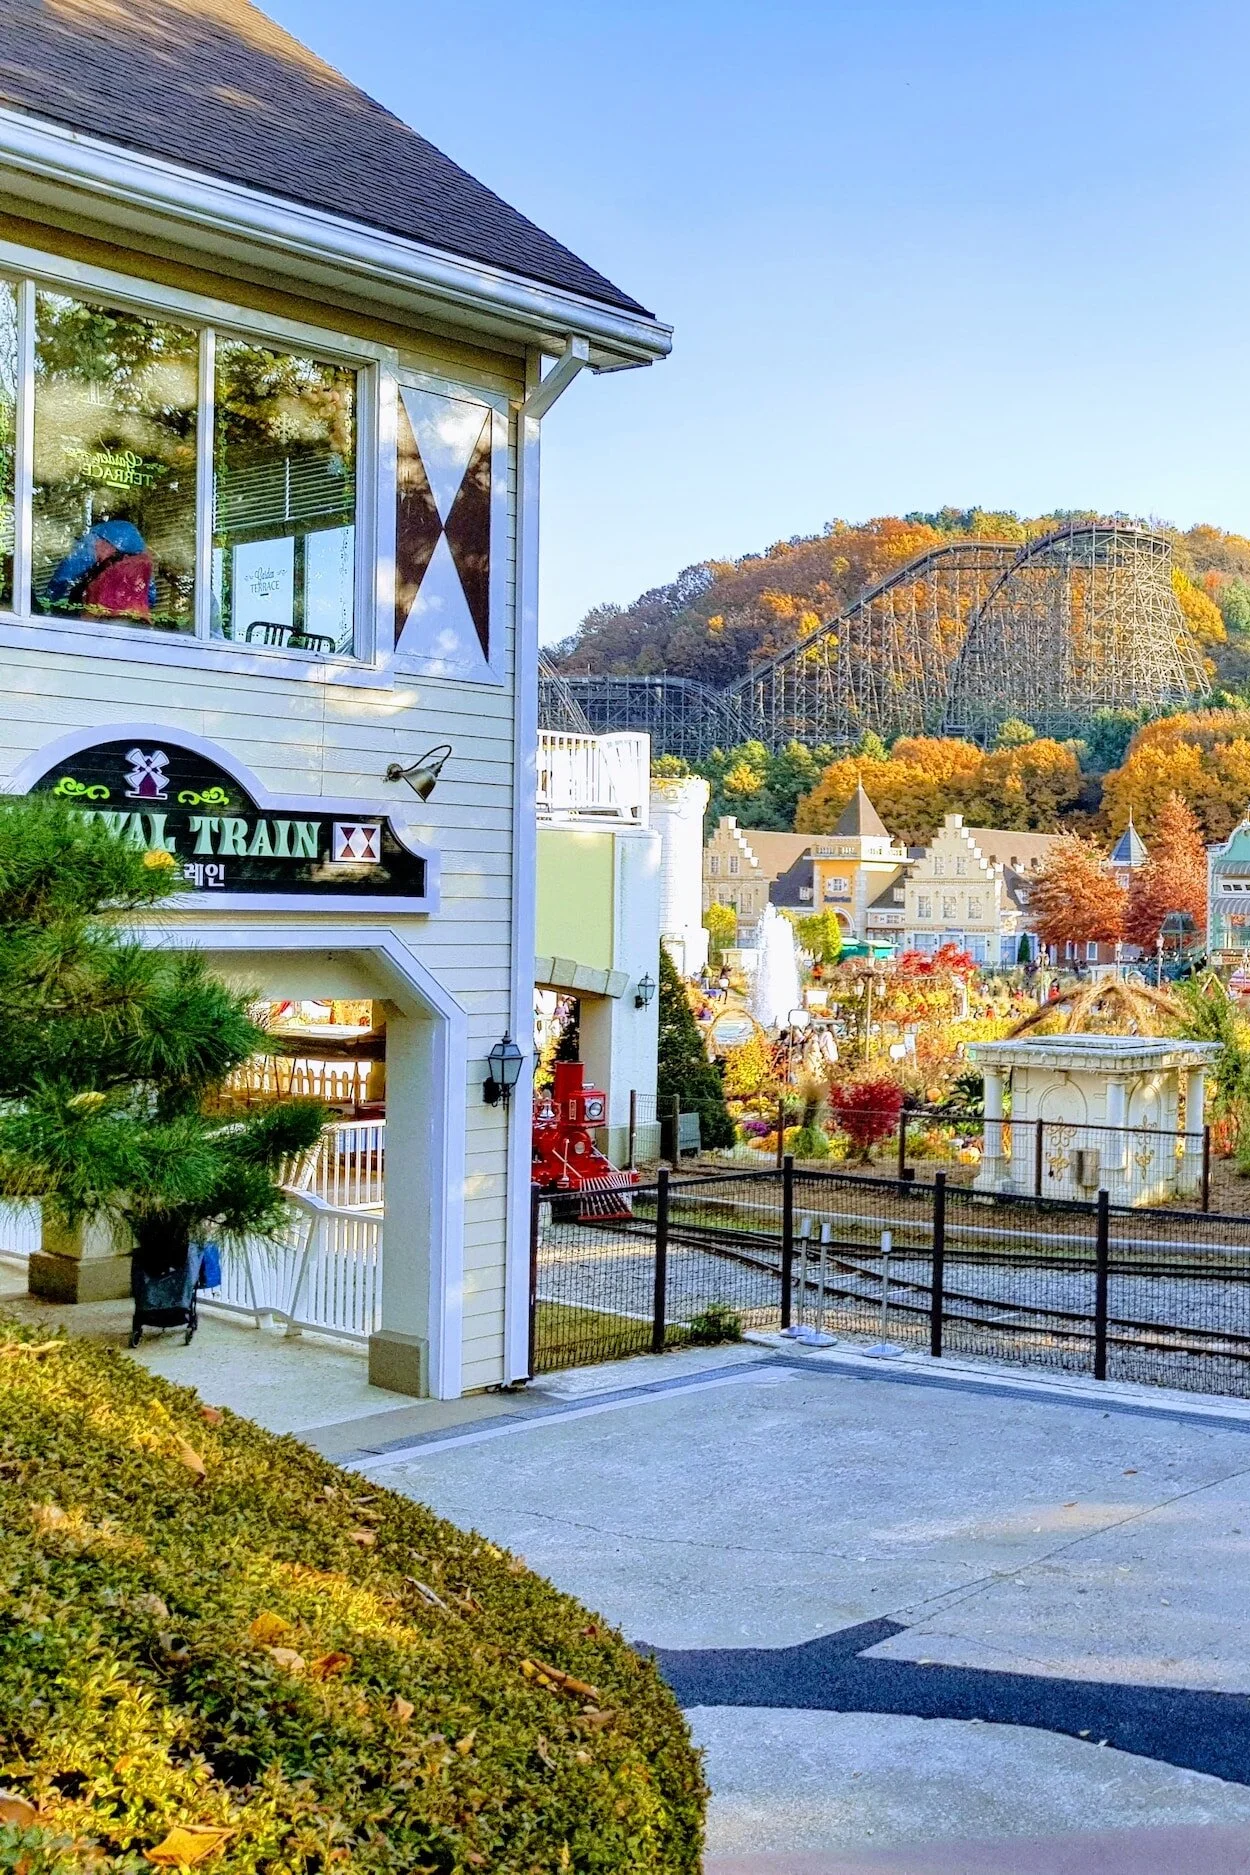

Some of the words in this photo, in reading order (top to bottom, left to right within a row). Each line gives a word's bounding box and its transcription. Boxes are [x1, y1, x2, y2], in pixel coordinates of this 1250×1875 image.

[250, 580, 280, 593] TERRACE
[188, 816, 322, 858] TRAIN
[171, 863, 225, 887] 레인
